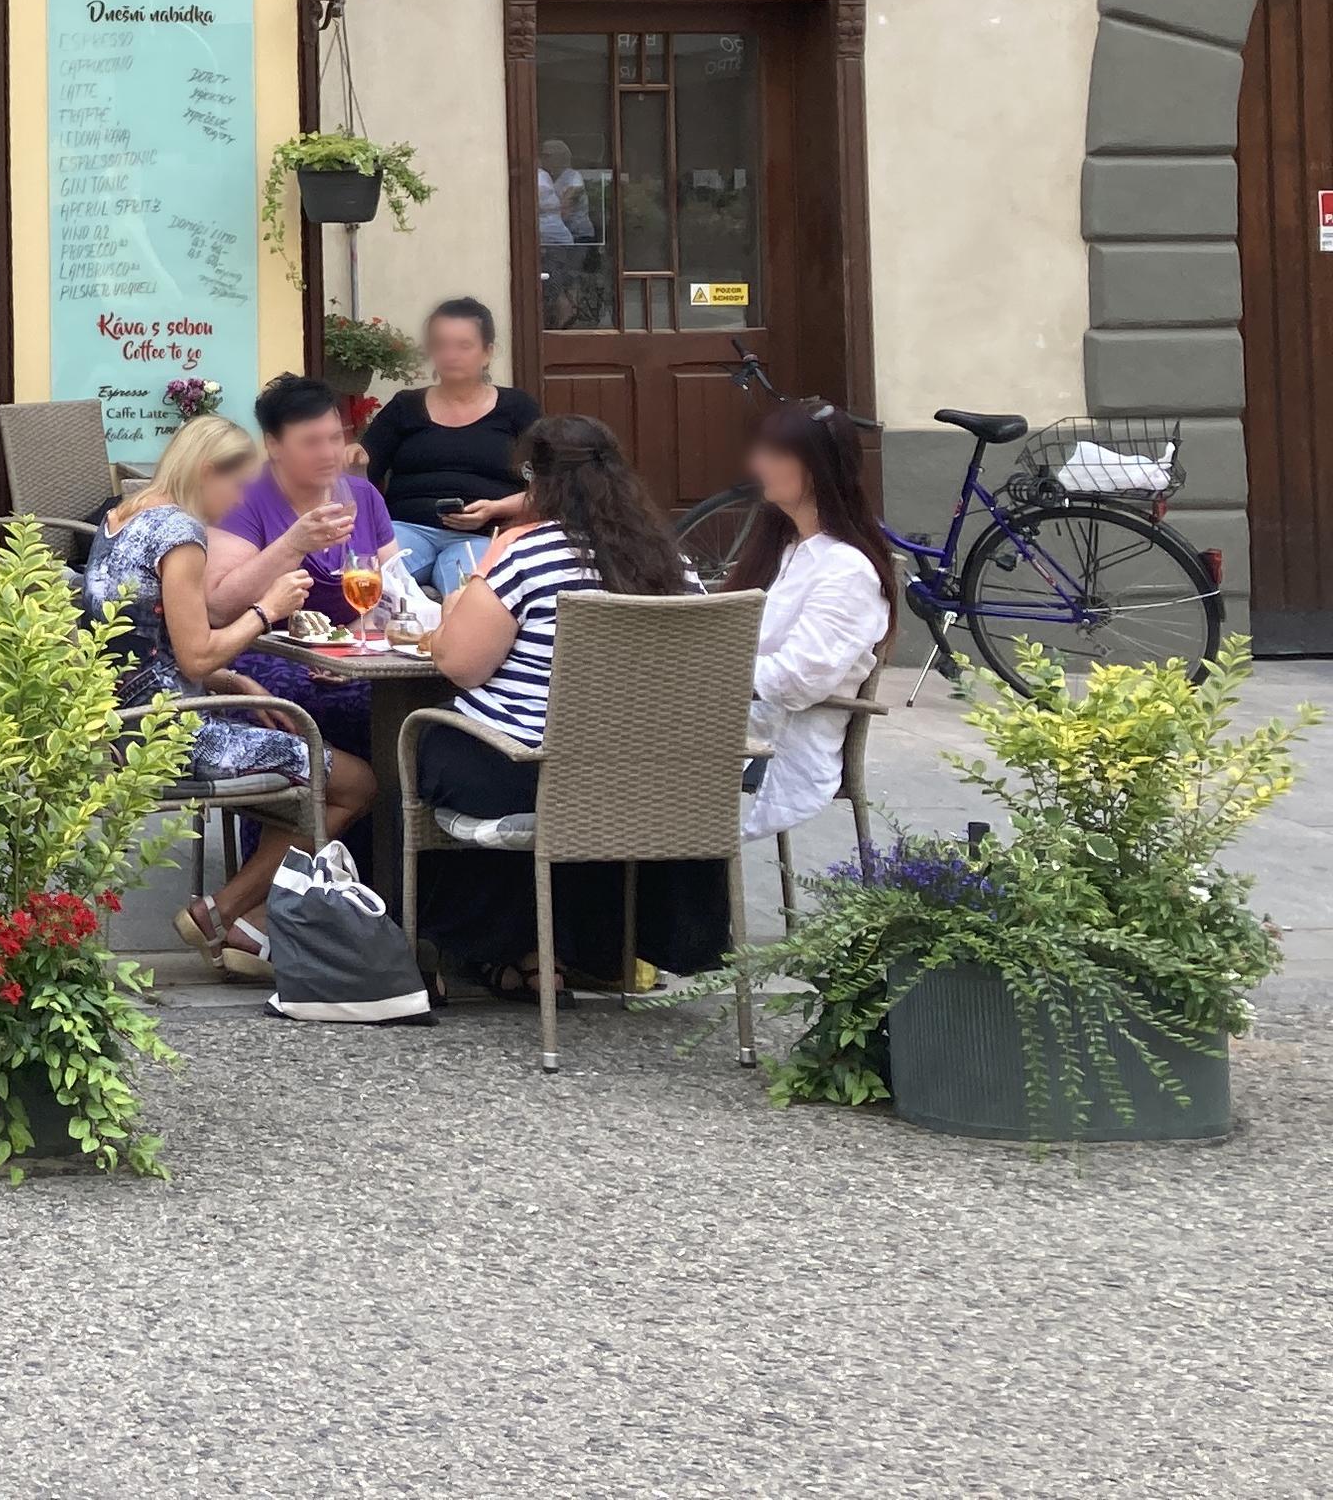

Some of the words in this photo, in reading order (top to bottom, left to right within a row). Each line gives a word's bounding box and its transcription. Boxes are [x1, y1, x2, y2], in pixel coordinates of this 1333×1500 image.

[86, 0, 146, 23] Dnešní
[150, 4, 215, 26] nabídka
[97, 312, 146, 341] Káva
[150, 319, 161, 337] s
[167, 316, 213, 337] sebou
[122, 340, 166, 362] Coffee
[167, 342, 182, 360] to
[182, 348, 202, 370] go
[98, 385, 151, 401] Espresso
[106, 407, 136, 419] Caffe
[140, 408, 169, 419] Latte
